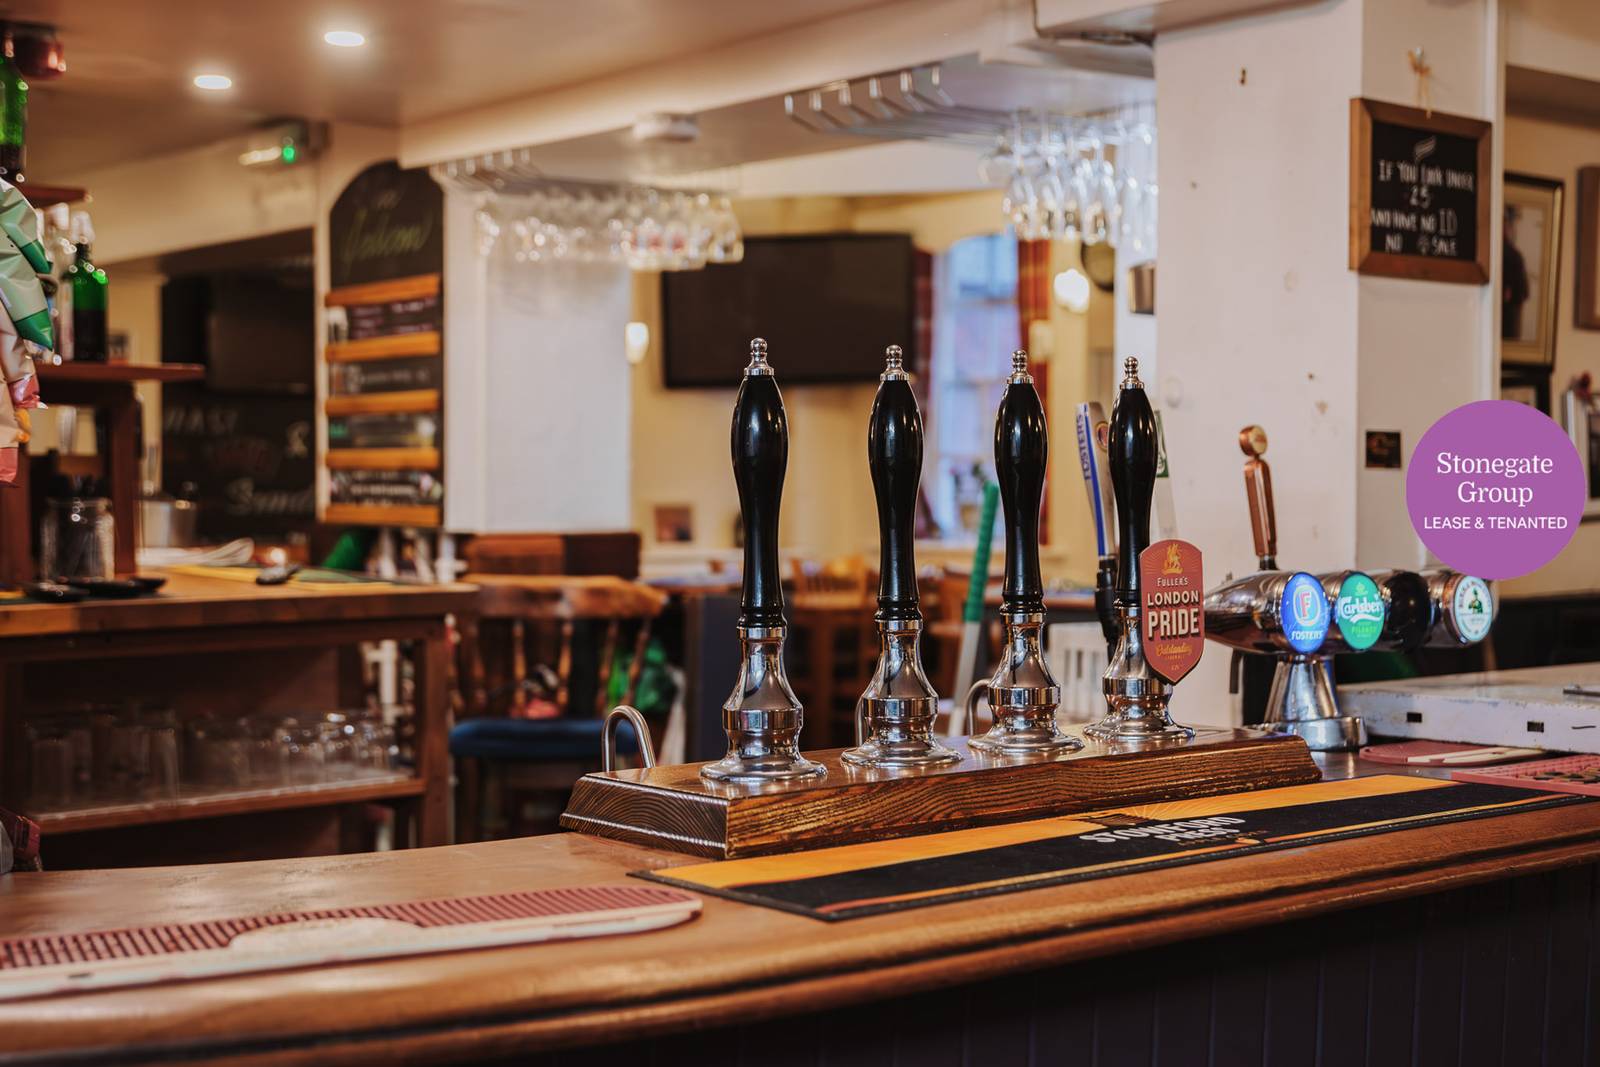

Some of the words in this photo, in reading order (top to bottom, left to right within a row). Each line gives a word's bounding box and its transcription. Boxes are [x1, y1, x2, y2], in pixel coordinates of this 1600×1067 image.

[1378, 160, 1392, 182] IF
[1397, 161, 1418, 184] YOU
[1410, 185, 1431, 209] 25
[1439, 208, 1457, 236] ID
[1385, 233, 1403, 254] NO
[1147, 590, 1199, 606] LONDON
[1148, 608, 1199, 638] PRIDE
